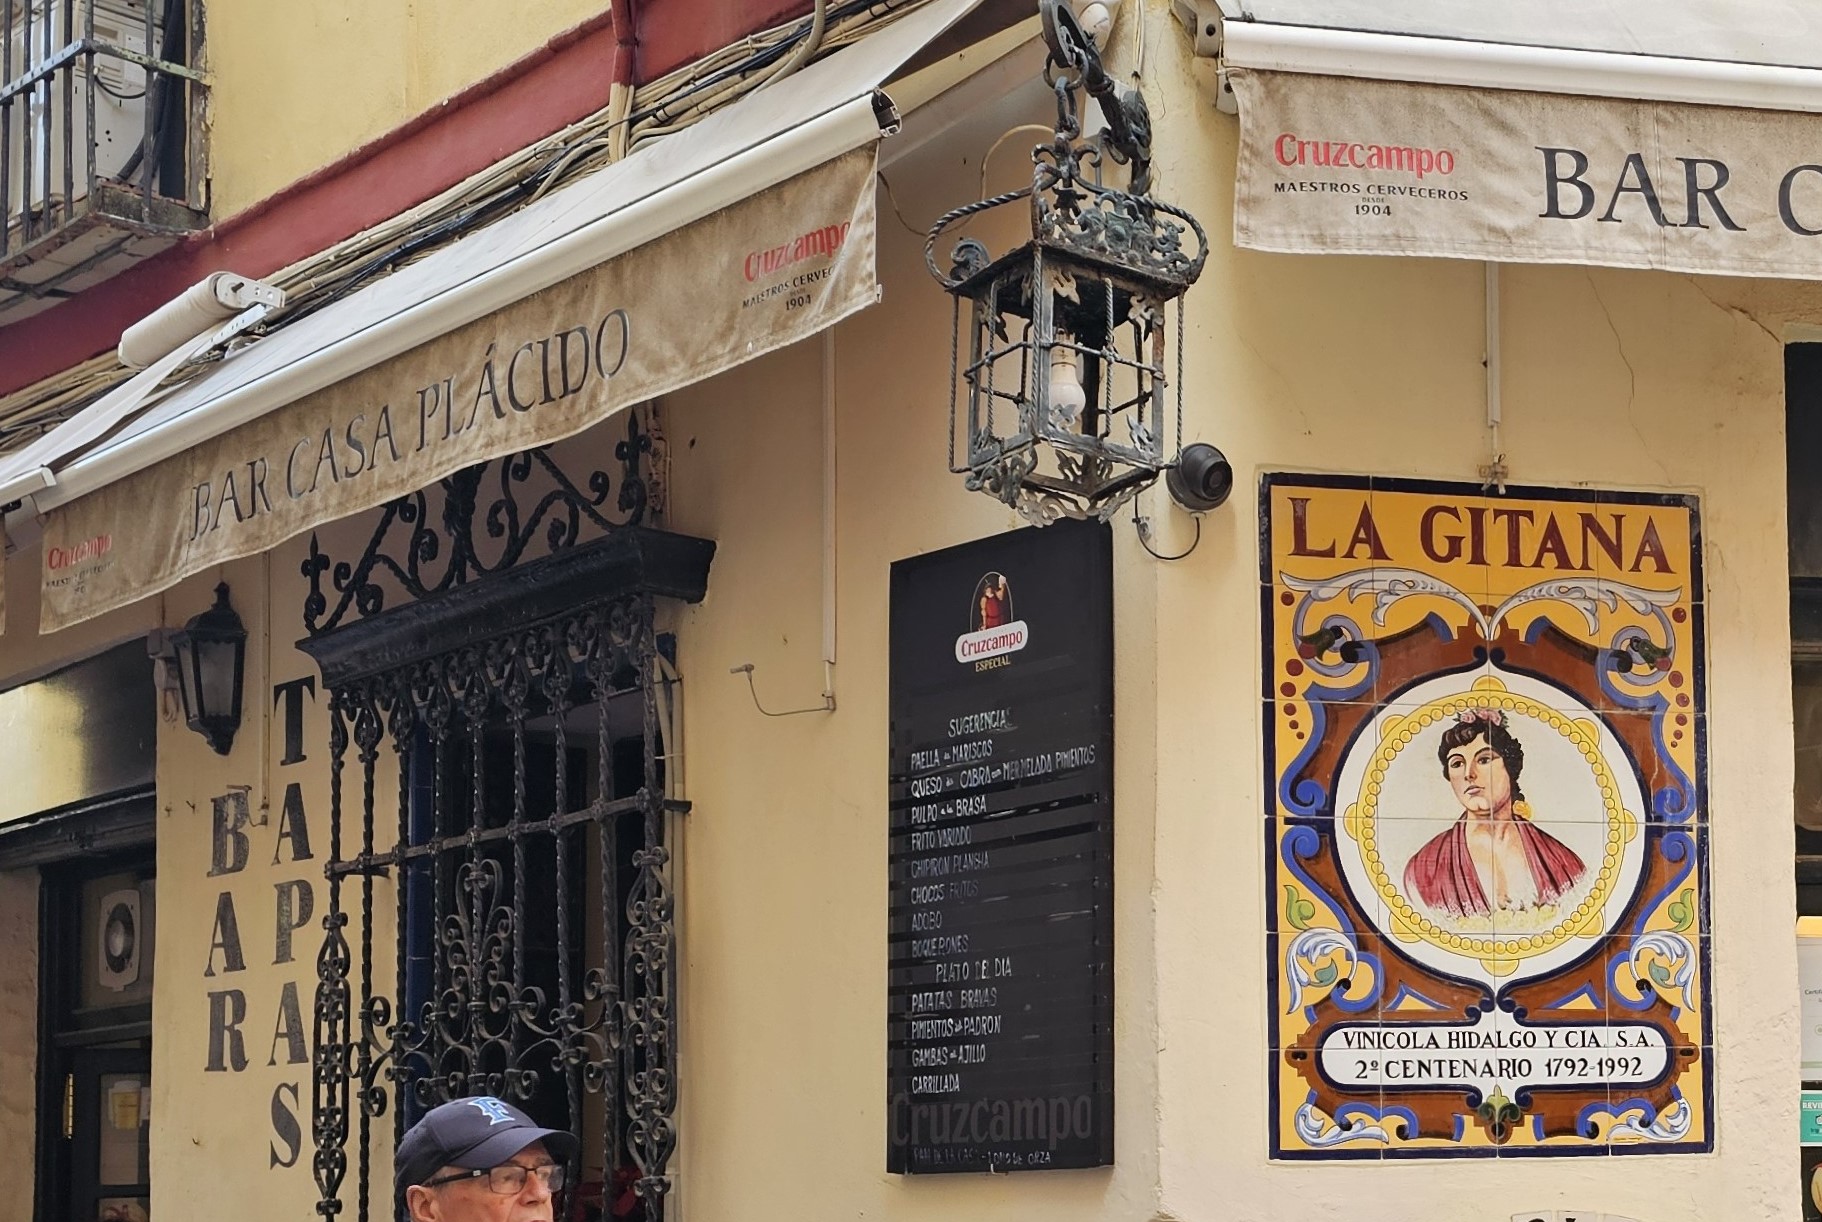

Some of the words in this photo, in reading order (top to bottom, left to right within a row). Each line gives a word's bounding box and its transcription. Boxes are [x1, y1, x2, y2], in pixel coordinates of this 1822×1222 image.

[1274, 133, 1455, 180] Cruzcampo
[1273, 181, 1361, 194] MAESTROS
[1366, 184, 1469, 202] CERVECEROS
[1535, 146, 1747, 231] BAR
[1355, 203, 1392, 217] 1904
[742, 281, 790, 309] MAESTROS
[792, 265, 836, 289] CERVEC
[785, 294, 812, 311] 1904
[189, 456, 272, 542] BAR
[286, 404, 400, 500] CASA
[415, 308, 630, 452] PLÁCIDO
[1287, 496, 1388, 560] LA
[1420, 505, 1676, 574] GITANA
[961, 631, 1023, 657] Cruzcampo
[975, 655, 1011, 672] ESPECIAL
[911, 749, 940, 771] PAELLA
[952, 739, 993, 763] MARISCOS
[911, 776, 942, 798] QUESO
[959, 766, 991, 788] CABRA
[1003, 754, 1052, 780] MERMELADA
[1055, 744, 1096, 769] PIMIENTOS
[911, 803, 938, 824] PULPO
[956, 795, 987, 817] BRASA
[911, 831, 936, 851] FRITO
[937, 826, 972, 848] VARIADO
[911, 884, 945, 904] CHOCOS
[203, 790, 250, 1074] BAR
[269, 677, 316, 1171] TAPAS
[911, 911, 942, 931] ADOBO
[912, 935, 969, 958] BOQUERONES
[936, 962, 969, 983] PLATO
[994, 956, 1012, 977] DIA
[912, 991, 953, 1013] PATATAS
[960, 987, 998, 1009] BRAVAS
[911, 1018, 954, 1040] PIMIENTOS
[964, 1015, 1002, 1036] PADRON
[1343, 1031, 1440, 1049] VINICOLA
[1448, 1030, 1538, 1049] HIDALGO
[1544, 1031, 1561, 1048] Y
[1615, 1031, 1655, 1048] S.A.
[912, 1047, 948, 1067] GAMBAS
[957, 1044, 986, 1064] AJILLO
[1385, 1057, 1533, 1080] CENTENARIO
[1544, 1056, 1643, 1078] 1792-1992
[912, 1073, 960, 1094] CARRILLADA
[892, 1092, 1092, 1150] Cruzcampo
